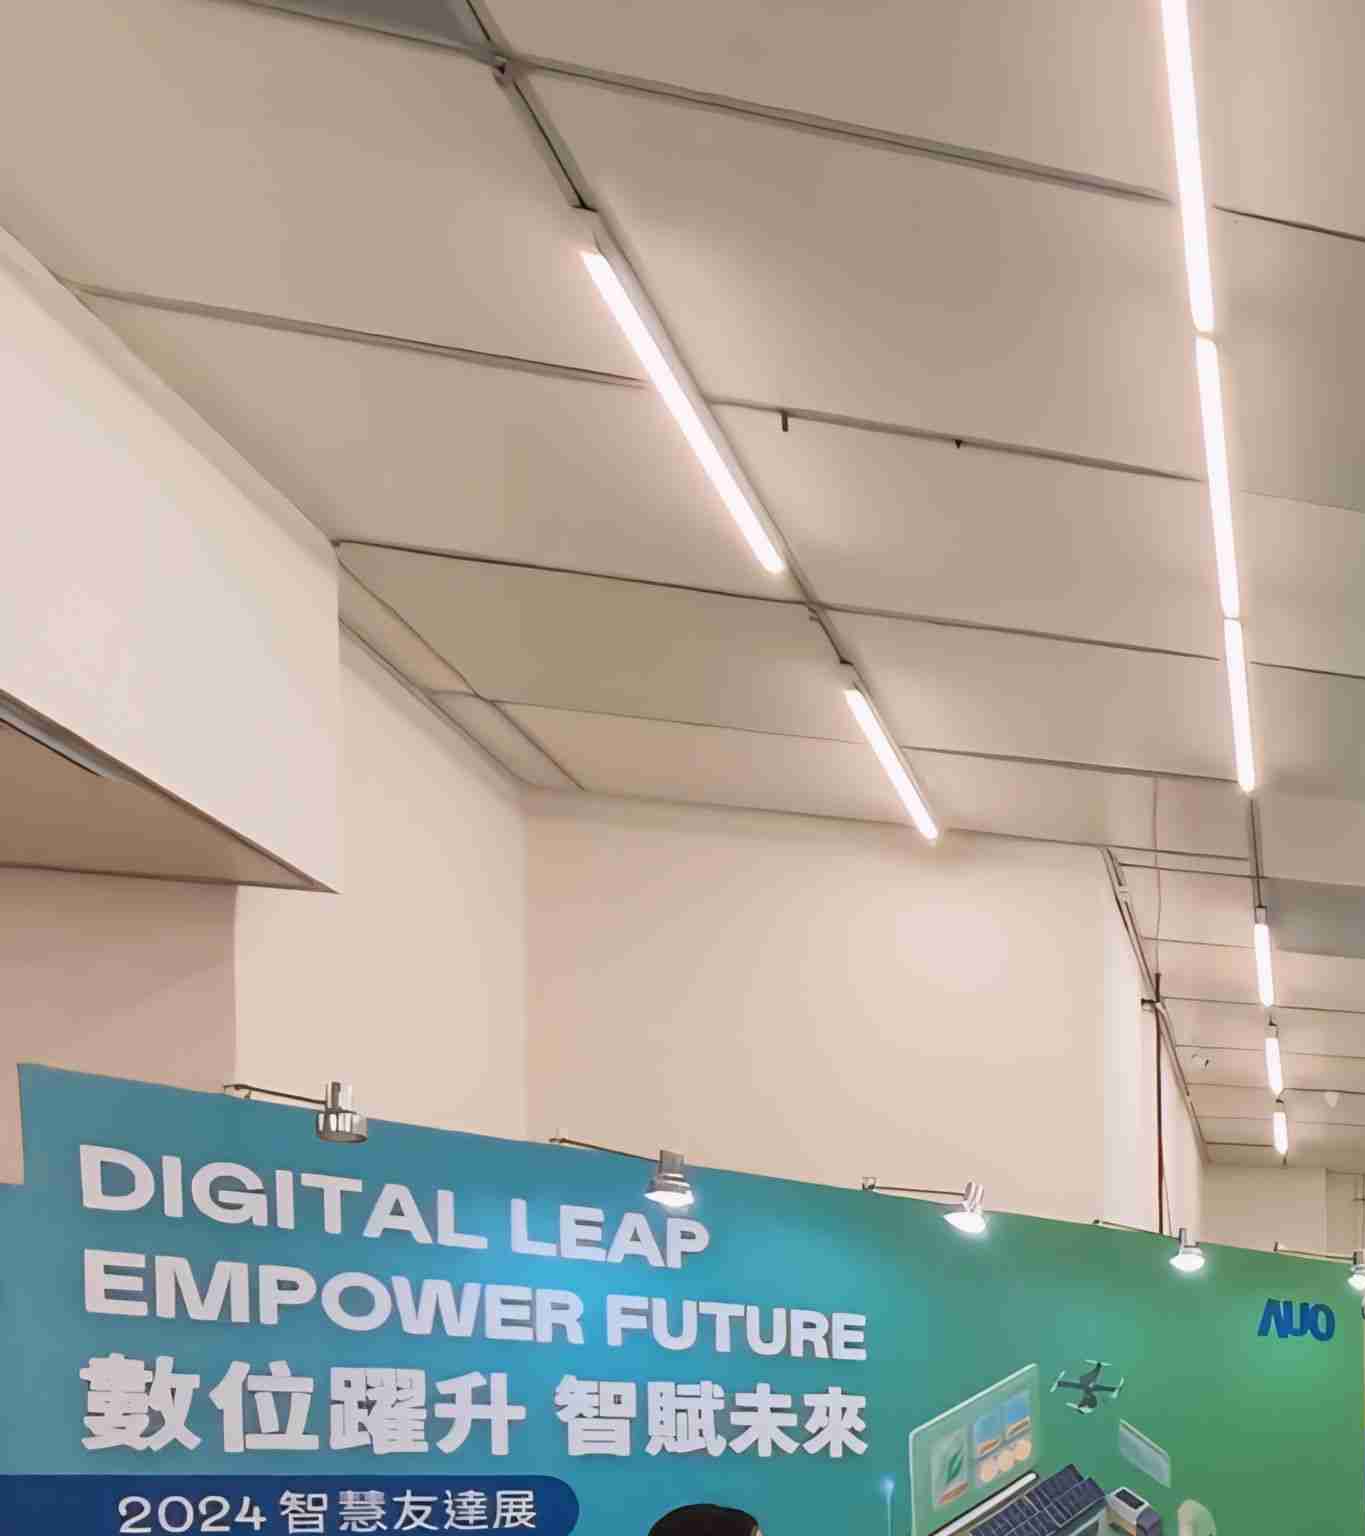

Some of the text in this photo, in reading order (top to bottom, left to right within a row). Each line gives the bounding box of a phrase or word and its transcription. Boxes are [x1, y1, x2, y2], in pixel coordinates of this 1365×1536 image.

[79, 1142, 711, 1269] DIGITAL LEAP
[83, 1247, 868, 1361] EMPOWER FUTURE
[1257, 1297, 1336, 1342] AUO
[79, 1352, 868, 1458] 數位躍升 智賦未來
[118, 1488, 538, 1534] 2024 智慧友達展
